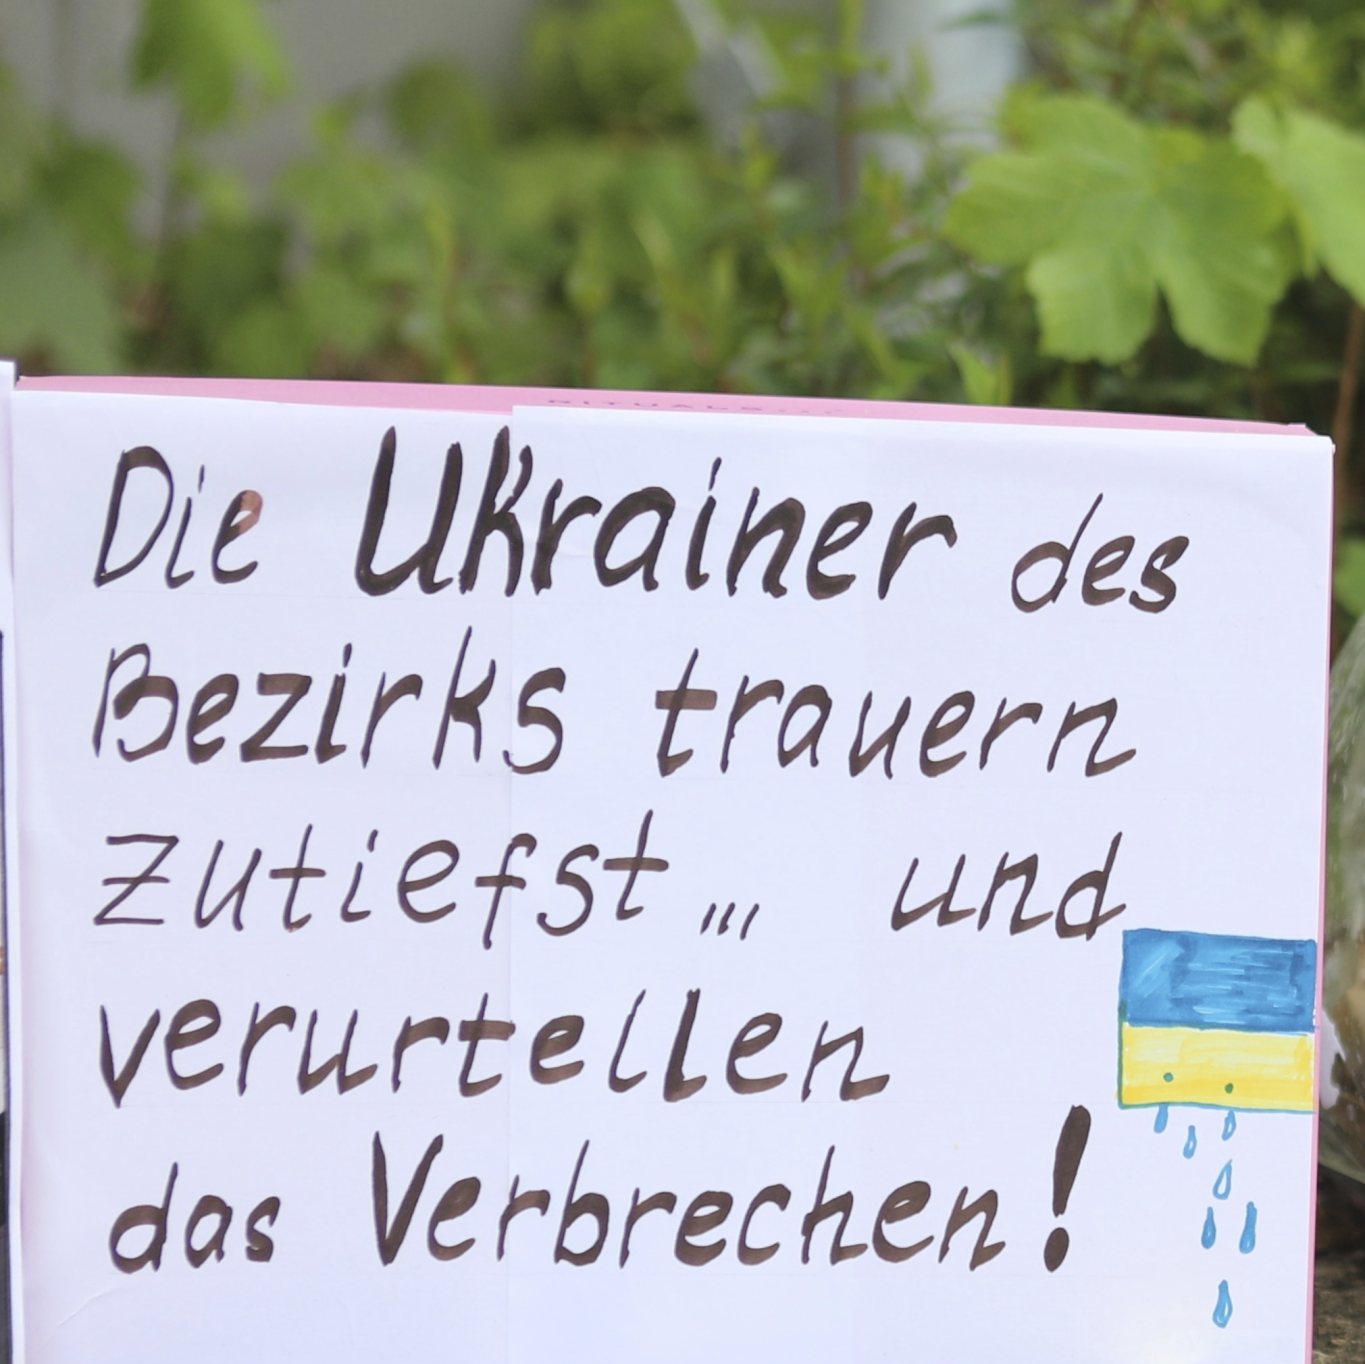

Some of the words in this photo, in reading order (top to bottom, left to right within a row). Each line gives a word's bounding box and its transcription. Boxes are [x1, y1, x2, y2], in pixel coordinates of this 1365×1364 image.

[92, 445, 263, 589] Die
[354, 426, 958, 600] Ukrainer
[1010, 493, 1190, 614] des
[92, 625, 567, 775] Bezirks
[655, 648, 1137, 778] trauern
[890, 831, 1128, 941] und
[109, 1162, 281, 1274] das
[372, 1104, 1092, 1273] Verbrechen!
